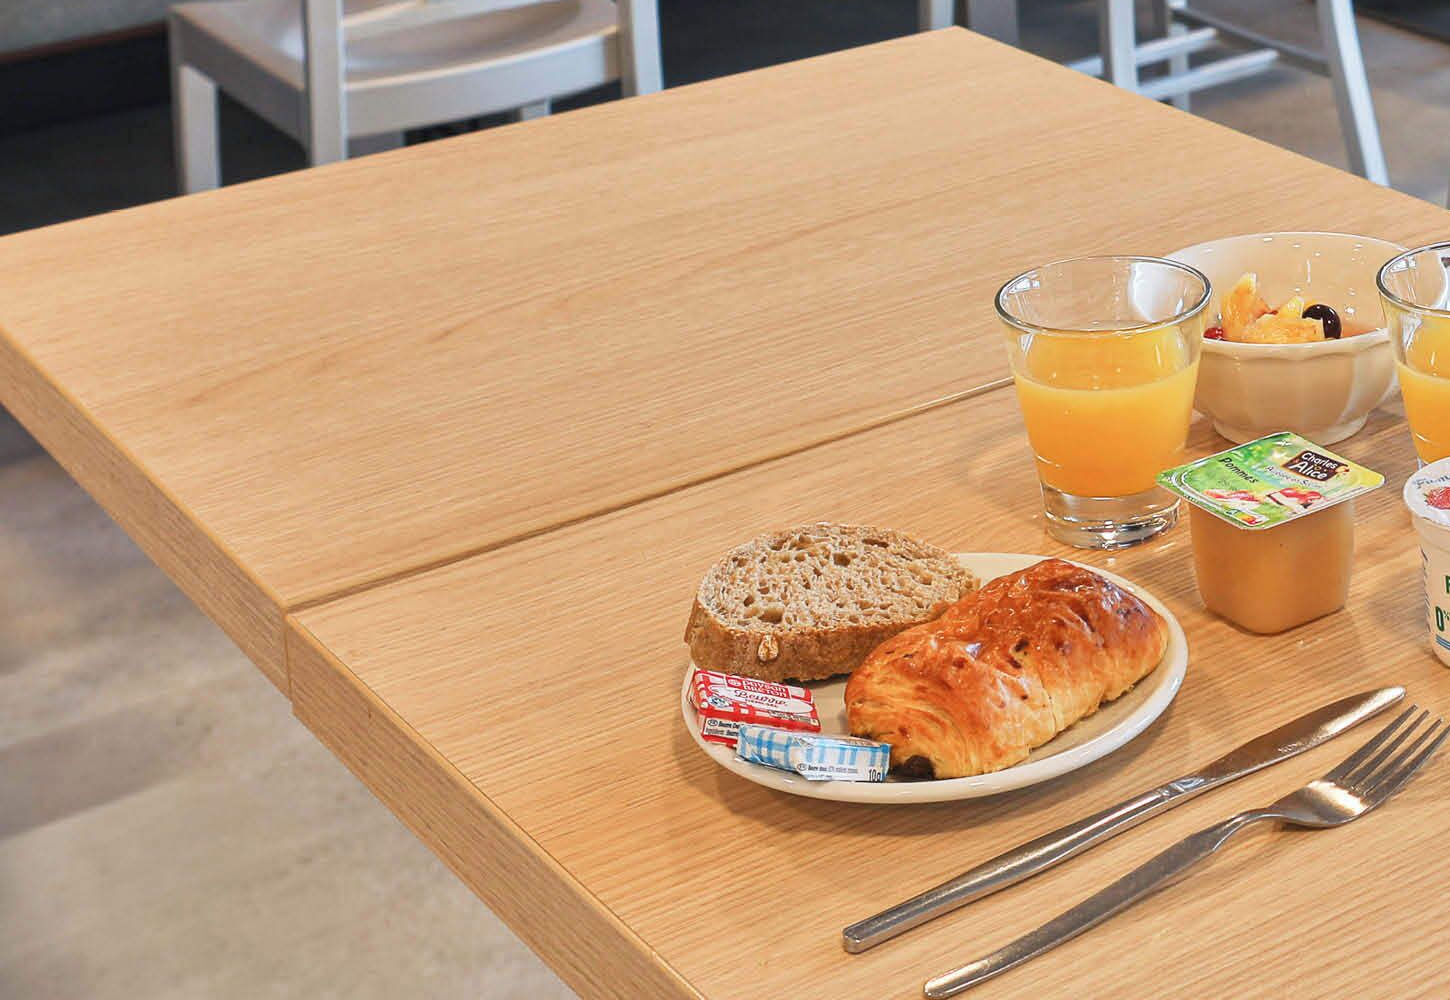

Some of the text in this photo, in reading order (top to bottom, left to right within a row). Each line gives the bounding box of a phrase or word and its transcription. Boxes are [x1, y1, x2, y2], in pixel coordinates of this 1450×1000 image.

[1301, 452, 1338, 469] Charles
[1217, 457, 1259, 484] Pommes
[1288, 461, 1328, 480] Alice
